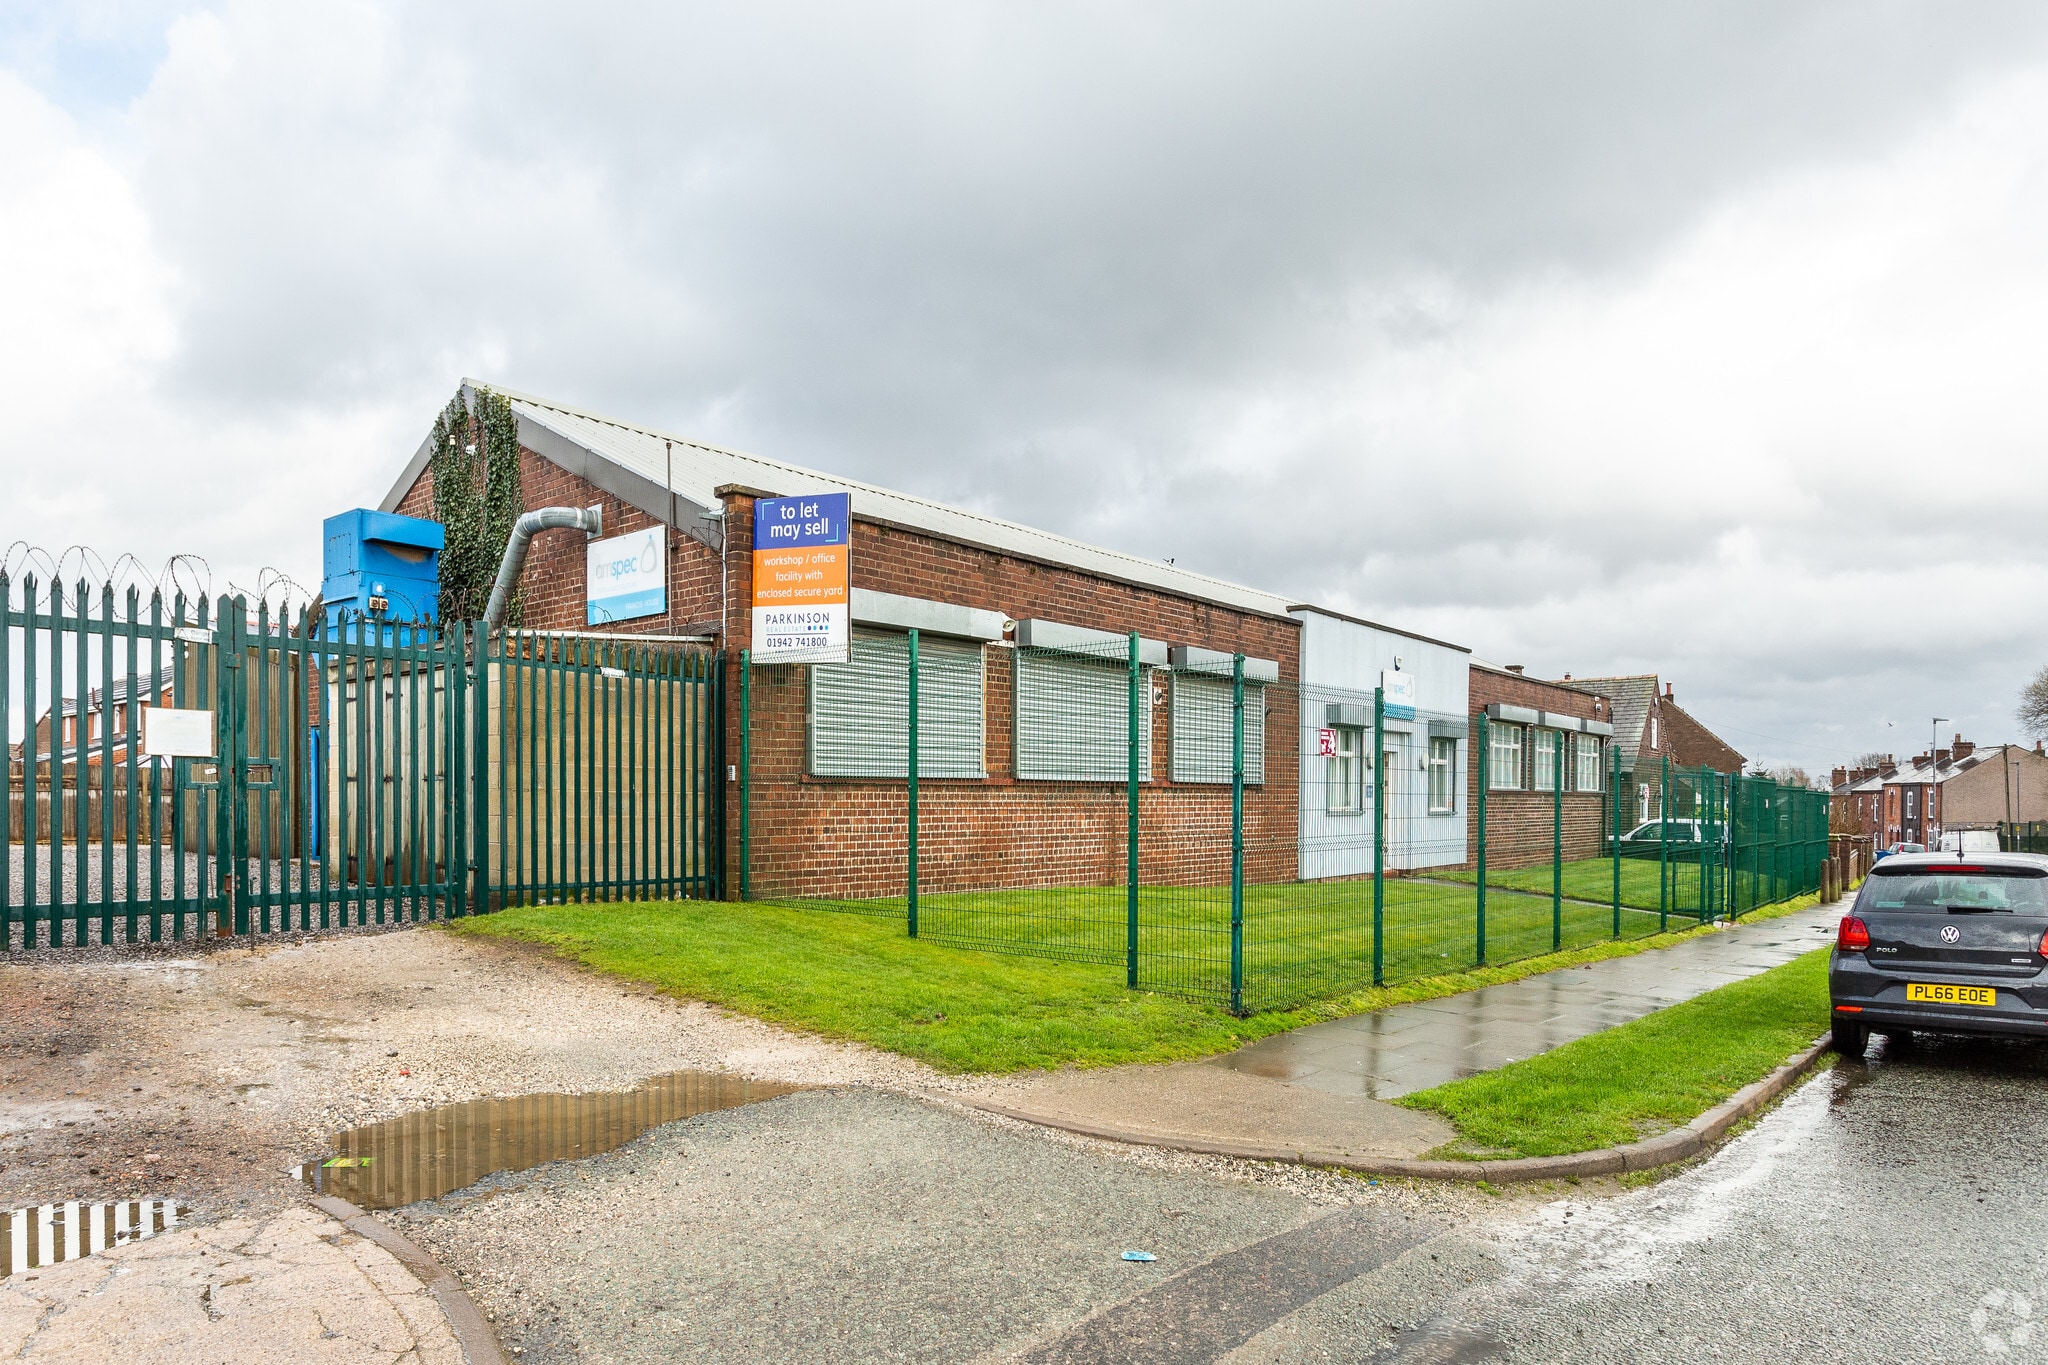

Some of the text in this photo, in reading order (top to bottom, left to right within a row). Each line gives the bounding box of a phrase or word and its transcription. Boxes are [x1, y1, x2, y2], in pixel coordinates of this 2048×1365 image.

[780, 502, 819, 520] to let
[770, 517, 829, 540] may sell
[764, 553, 836, 567] workshop / office
[776, 569, 823, 583] facility with
[757, 585, 843, 599] enclosed secure yard
[766, 612, 830, 625] PARKINSON
[766, 636, 828, 648] 01942 741800
[1915, 986, 1989, 1002] PL66 EOE
